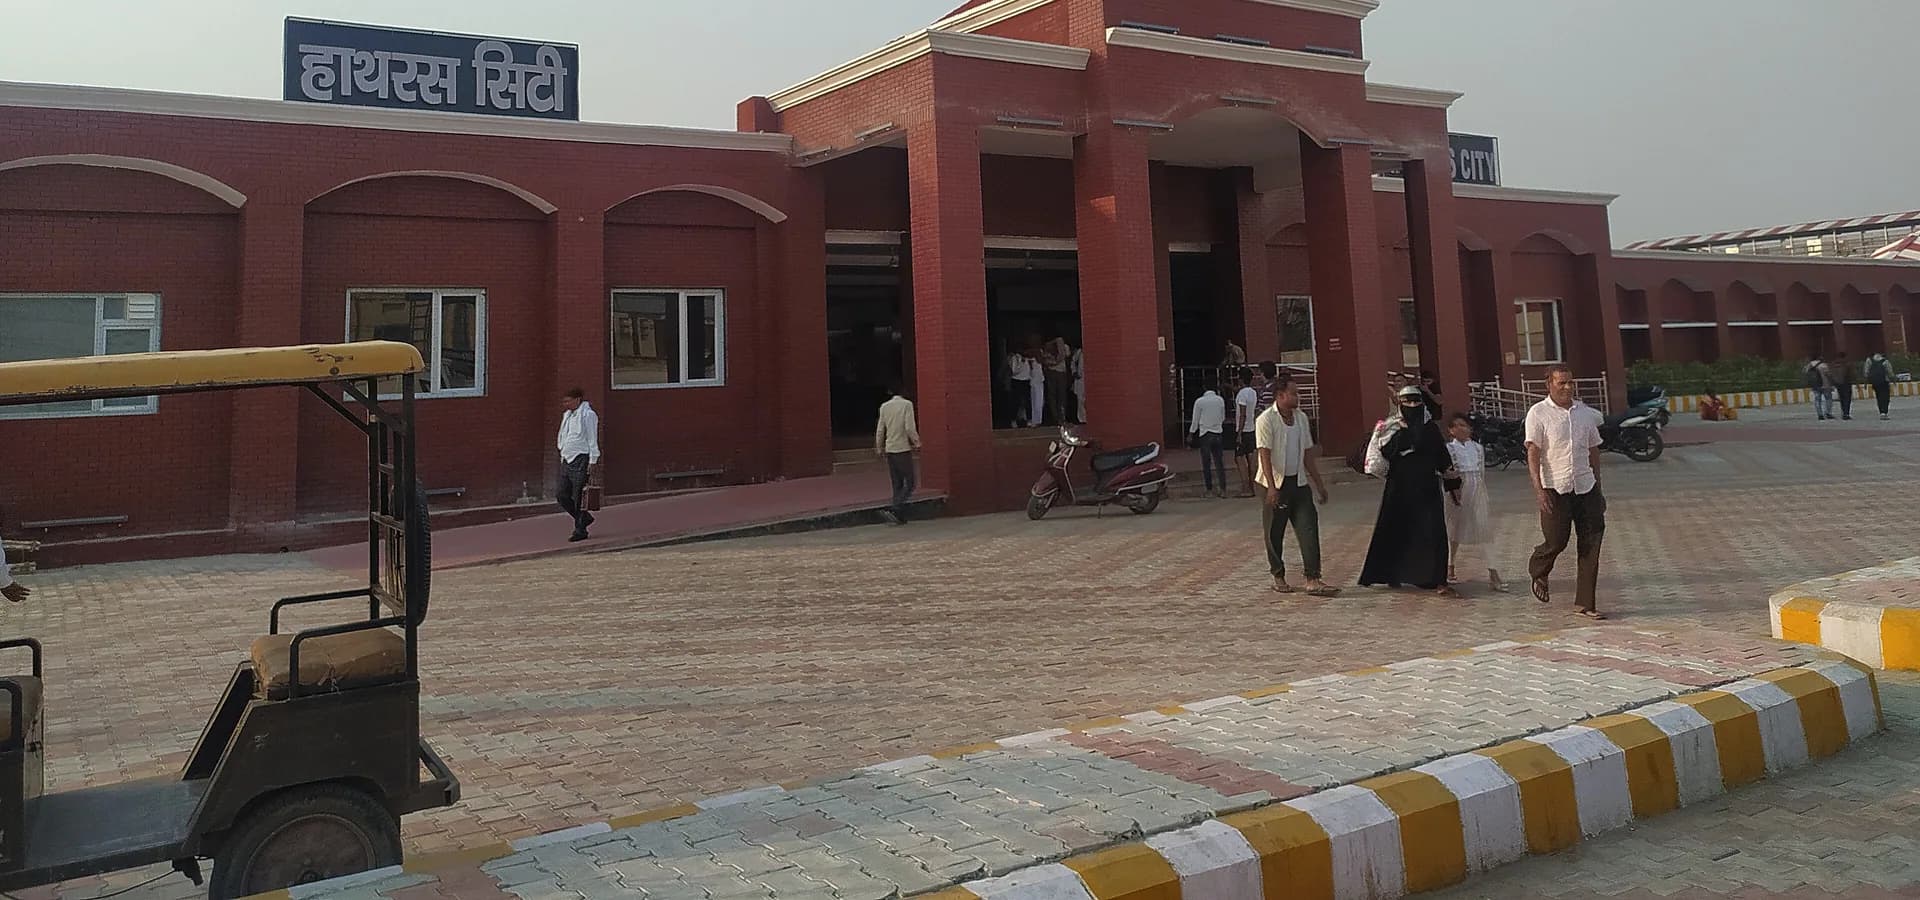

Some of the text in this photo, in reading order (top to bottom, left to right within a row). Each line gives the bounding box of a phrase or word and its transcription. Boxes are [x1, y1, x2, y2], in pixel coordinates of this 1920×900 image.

[299, 40, 567, 112] हाथरस सिटी
[1461, 149, 1495, 182] CITY
